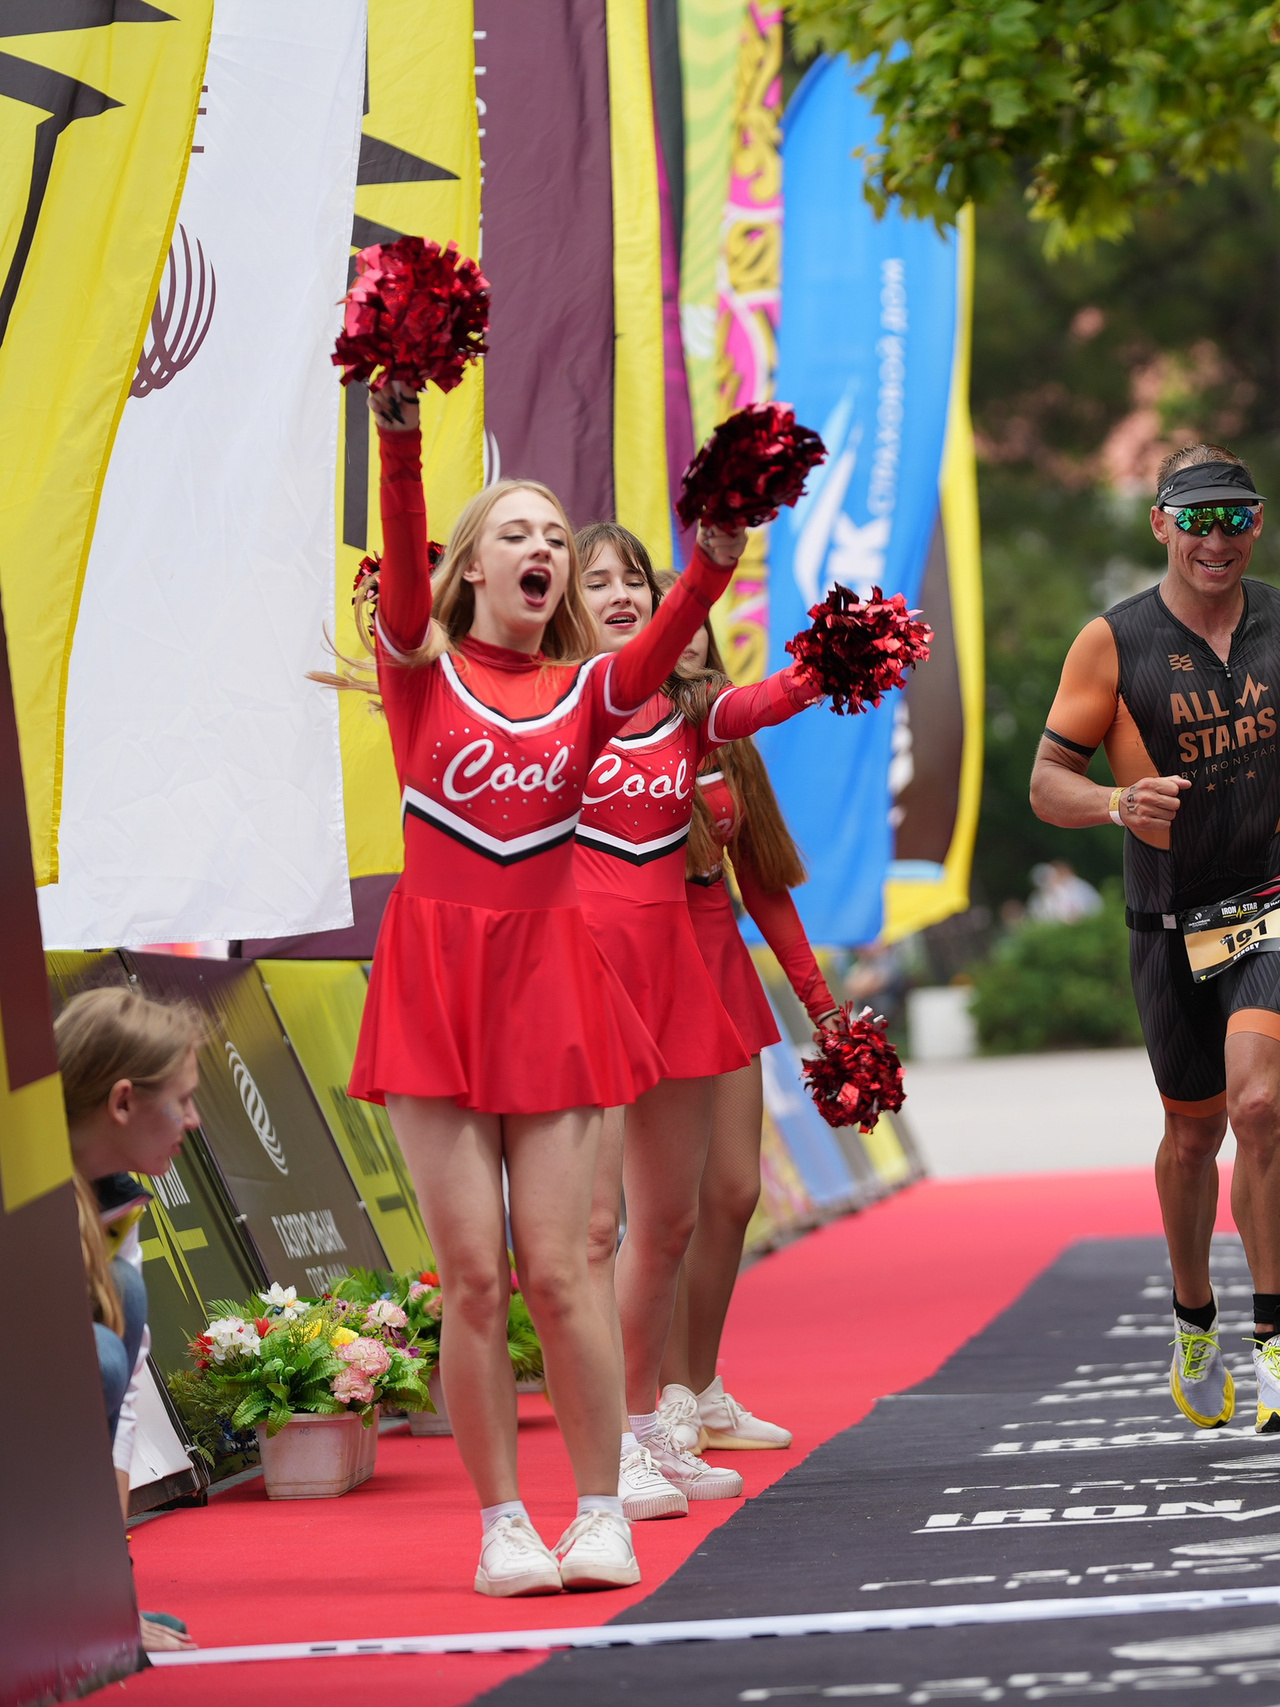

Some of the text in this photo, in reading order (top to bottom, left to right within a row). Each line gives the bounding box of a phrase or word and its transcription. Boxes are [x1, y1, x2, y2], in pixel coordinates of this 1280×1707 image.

[1170, 690, 1230, 725] ALL
[1178, 707, 1277, 763] STARS
[442, 738, 570, 801] Cool
[582, 754, 690, 804] Cool
[1221, 905, 1237, 915] IRON
[1242, 902, 1258, 912] STAR
[1220, 919, 1268, 954] 191
[924, 1499, 1246, 1528] IRON
